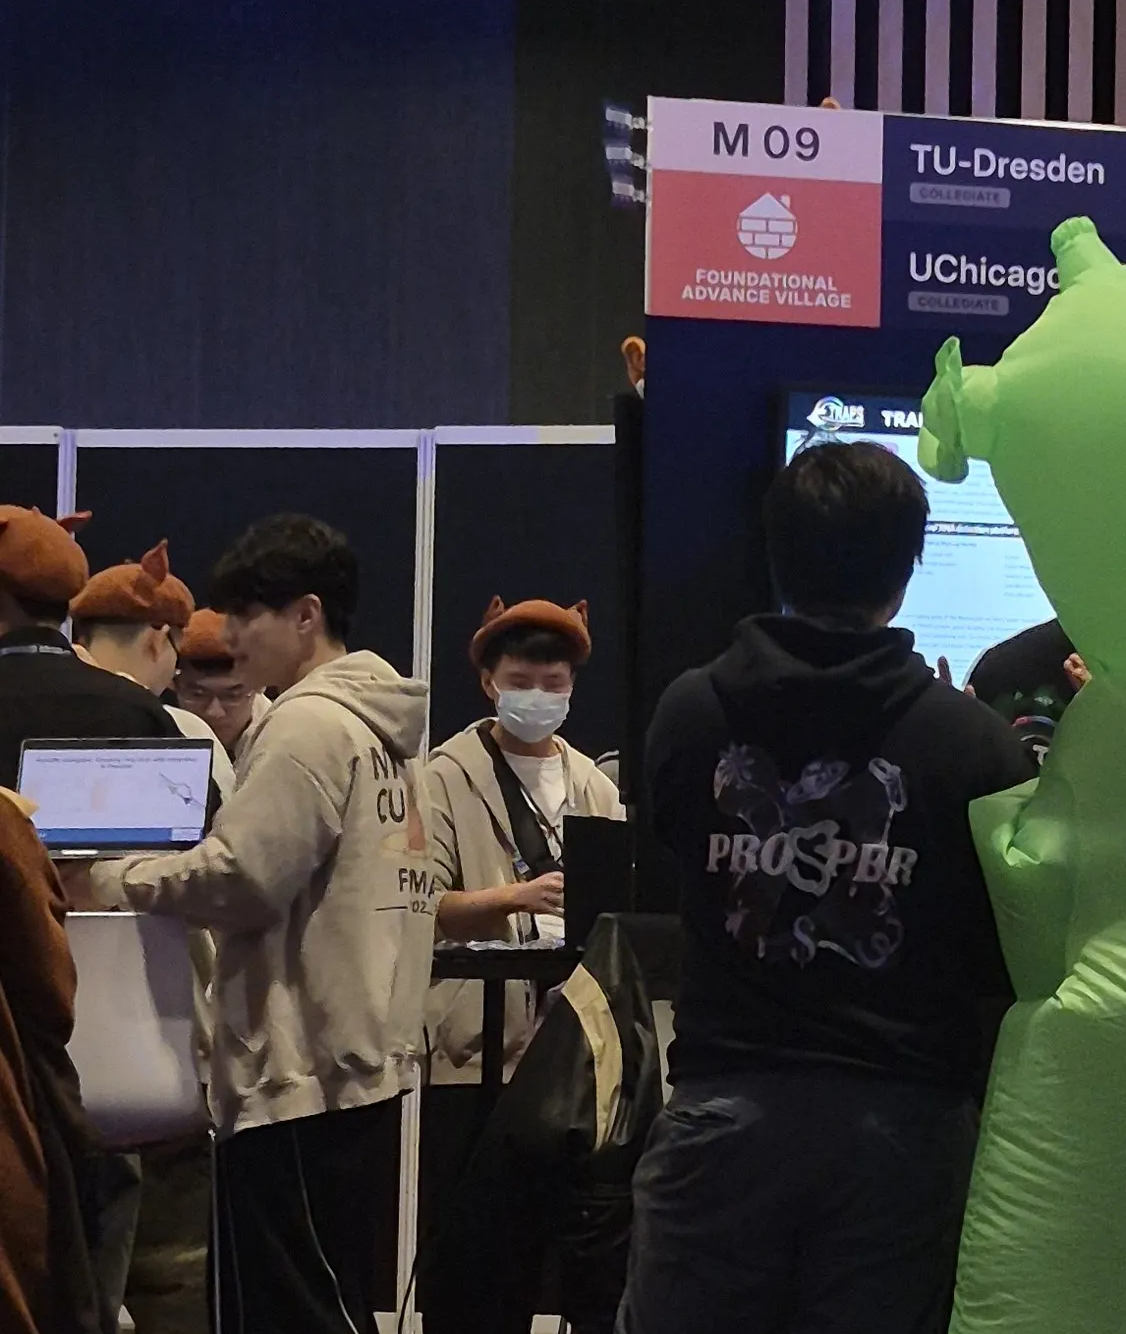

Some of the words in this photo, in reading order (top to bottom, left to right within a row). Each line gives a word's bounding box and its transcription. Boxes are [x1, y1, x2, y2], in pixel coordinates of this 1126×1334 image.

[713, 121, 749, 157] M
[763, 125, 820, 162] 09
[910, 143, 1105, 185] TU-Dresden
[682, 284, 770, 304] ADVANCE
[775, 290, 852, 309] VILLAGE
[695, 268, 838, 292] FOUNDATIONAL
[376, 787, 405, 824] CU
[706, 819, 918, 896] PROSPER
